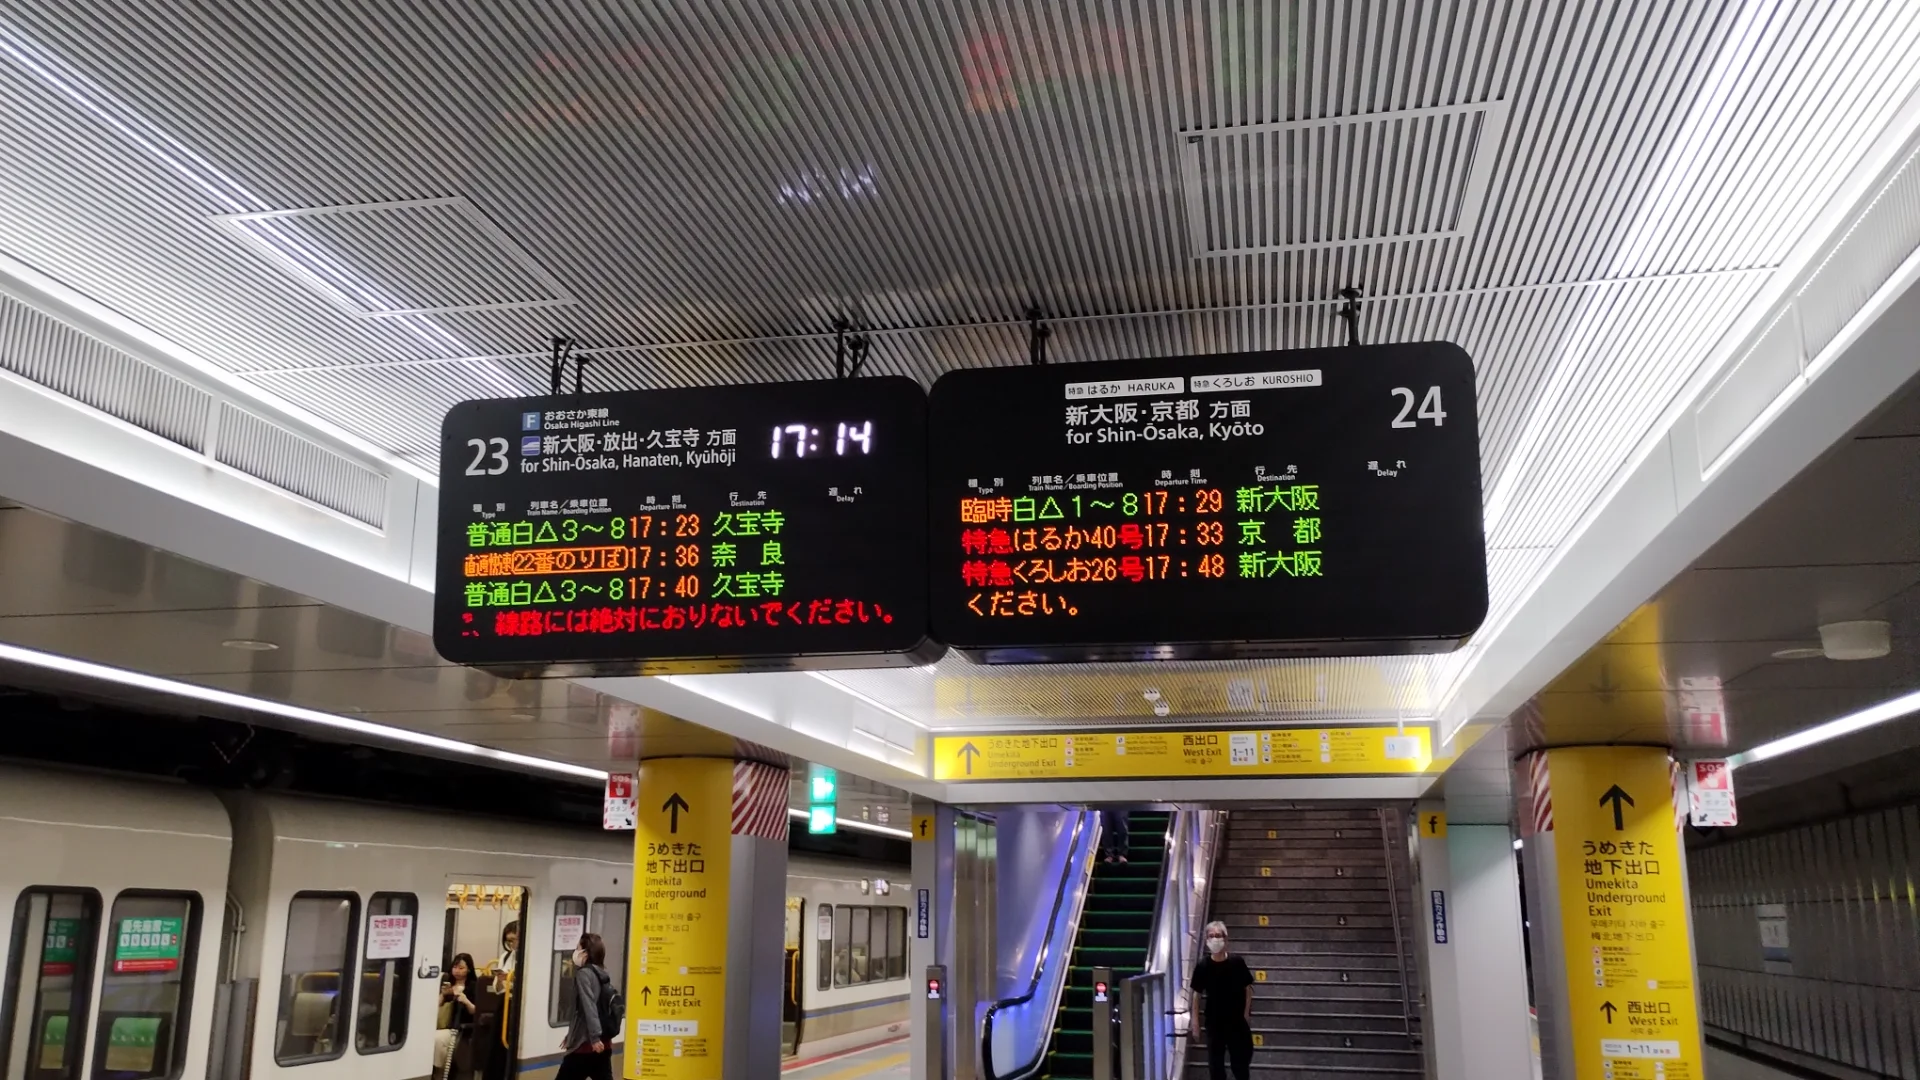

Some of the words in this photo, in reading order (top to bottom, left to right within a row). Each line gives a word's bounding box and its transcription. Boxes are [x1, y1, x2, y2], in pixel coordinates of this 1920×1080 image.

[1194, 379, 1210, 389] 特急
[1213, 376, 1255, 389] くろしお
[1262, 373, 1314, 385] KUROSHIO
[1069, 386, 1084, 396] 特急
[1087, 383, 1121, 395] はるか
[1128, 381, 1176, 392] HARUKA
[1065, 399, 1200, 426] 新大阪・京都
[1209, 400, 1251, 419] 方面
[1391, 385, 1448, 429] 24
[544, 408, 609, 420] おおさか東線
[526, 414, 536, 428] F
[571, 418, 600, 429] Higashi
[602, 418, 620, 428] Line
[706, 429, 737, 447] 方面
[1065, 429, 1093, 444] for
[1097, 423, 1204, 443] Shin-Ōsaka,
[1209, 421, 1265, 441] Kyōto
[770, 420, 873, 459] 17:14
[465, 437, 509, 476] 23
[521, 458, 540, 473] for
[542, 453, 619, 472] Shin-Ōsaka,
[623, 450, 683, 468] Hanaten,
[686, 449, 736, 467] Kyūhōji
[1257, 474, 1296, 483] Destination
[1377, 469, 1398, 478] Delay
[1028, 483, 1044, 492] Train
[1098, 480, 1124, 490] Position
[1155, 477, 1190, 487] Departure
[1190, 477, 1208, 485] Time
[978, 486, 994, 495] Type
[731, 499, 765, 507] Destination
[836, 494, 855, 503] Delay
[1236, 485, 1320, 513] 新大阪
[527, 508, 543, 517] Train
[589, 506, 612, 514] Position
[640, 503, 670, 511] Departure
[671, 502, 687, 510] Time
[482, 511, 496, 519] Type
[712, 509, 785, 537] 久宝寺
[1239, 550, 1323, 578] 新大阪
[711, 570, 785, 598] 久宝寺
[967, 590, 1078, 616] ください。
[1183, 734, 1218, 746] 西出口
[1183, 748, 1204, 757] West
[1206, 748, 1222, 756] Exit
[1041, 758, 1057, 767] Exit
[611, 774, 631, 783] SOS
[647, 842, 702, 857] うめきた
[1582, 840, 1655, 857] うめきた
[646, 859, 705, 874] 地下出口
[1584, 859, 1660, 875] 地下出口
[645, 876, 683, 887] Umekita
[1585, 878, 1638, 890] Umekita
[644, 887, 707, 900] Underground
[1587, 891, 1666, 906] Underground
[643, 900, 659, 911] Exit
[1588, 905, 1612, 917] Exit
[659, 985, 695, 997] 西出口
[658, 998, 681, 1007] West
[682, 998, 701, 1007] Exit
[1628, 1001, 1671, 1014] 西出口
[1628, 1016, 1657, 1026] West
[1660, 1016, 1679, 1026] Exit
